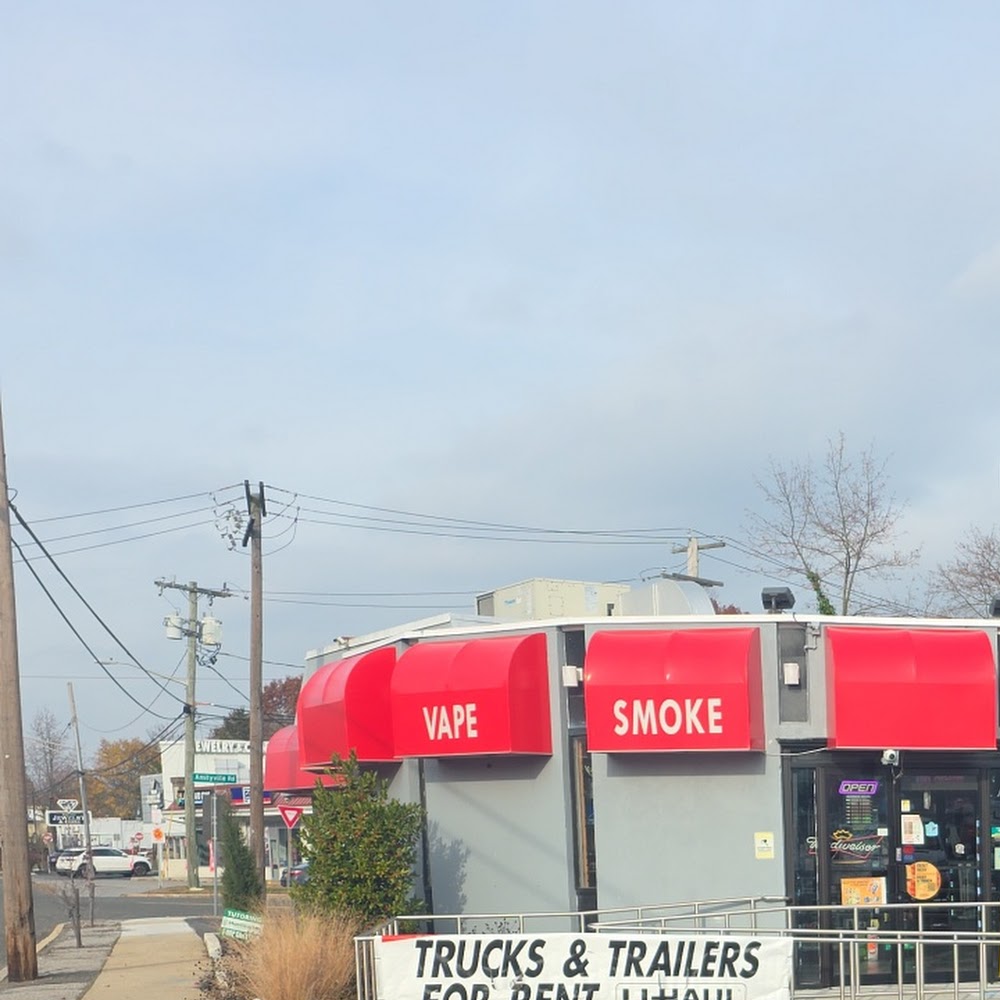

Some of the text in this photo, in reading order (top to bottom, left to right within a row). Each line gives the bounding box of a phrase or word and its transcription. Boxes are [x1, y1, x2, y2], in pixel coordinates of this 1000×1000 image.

[422, 703, 479, 740] VAPE
[613, 698, 723, 736] SMOKE
[195, 740, 234, 753] EWELRY
[195, 774, 226, 782] Amityville
[843, 783, 875, 792] OPEN
[415, 938, 762, 979] TRUCKS & TRAILERS
